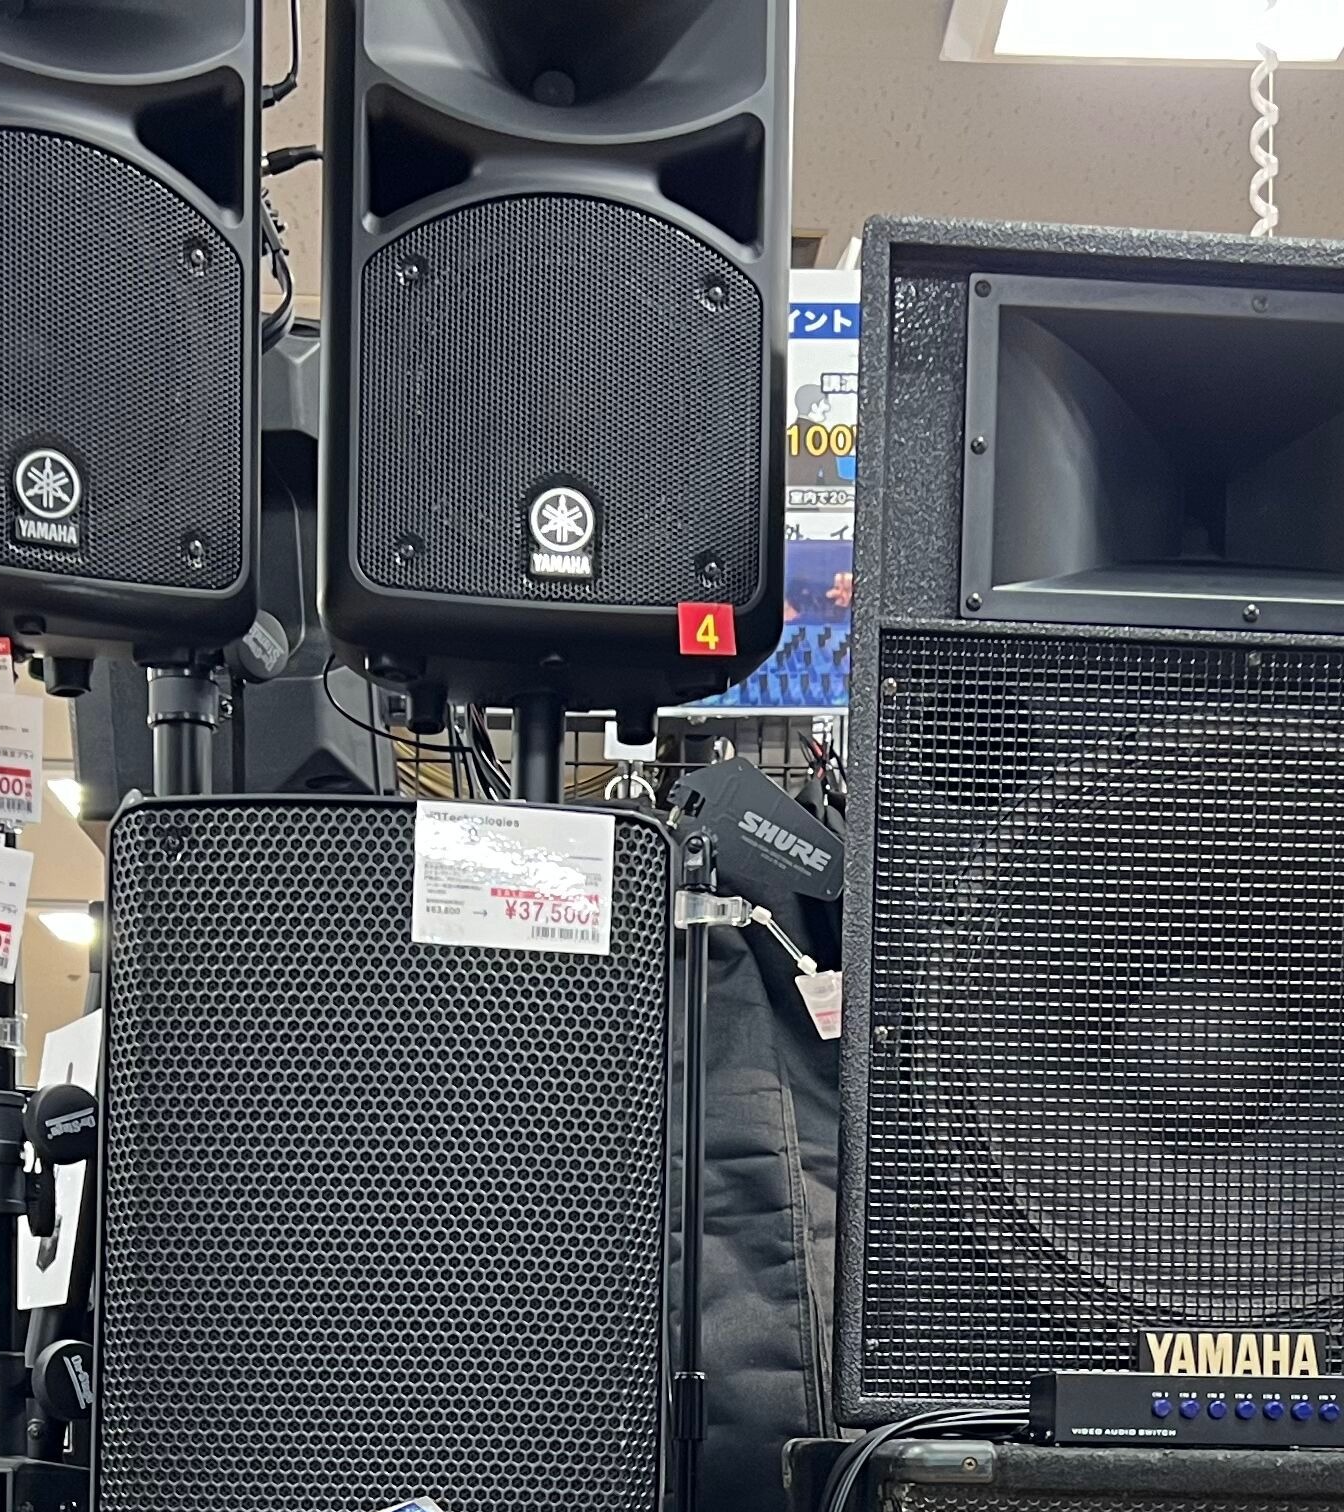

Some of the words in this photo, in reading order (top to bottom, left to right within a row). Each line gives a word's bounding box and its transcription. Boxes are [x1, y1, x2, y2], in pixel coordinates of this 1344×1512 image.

[19, 519, 78, 546] YAMAHA
[532, 552, 591, 576] YAMAHA
[696, 613, 720, 650] 4
[737, 810, 832, 872] SHURE
[505, 899, 591, 925] ¥37,500
[1145, 1332, 1319, 1376] YAMAHA
[1071, 1427, 1103, 1436] VIDEO
[1104, 1428, 1137, 1436] AUDIO
[1138, 1428, 1177, 1437] SWITCH
